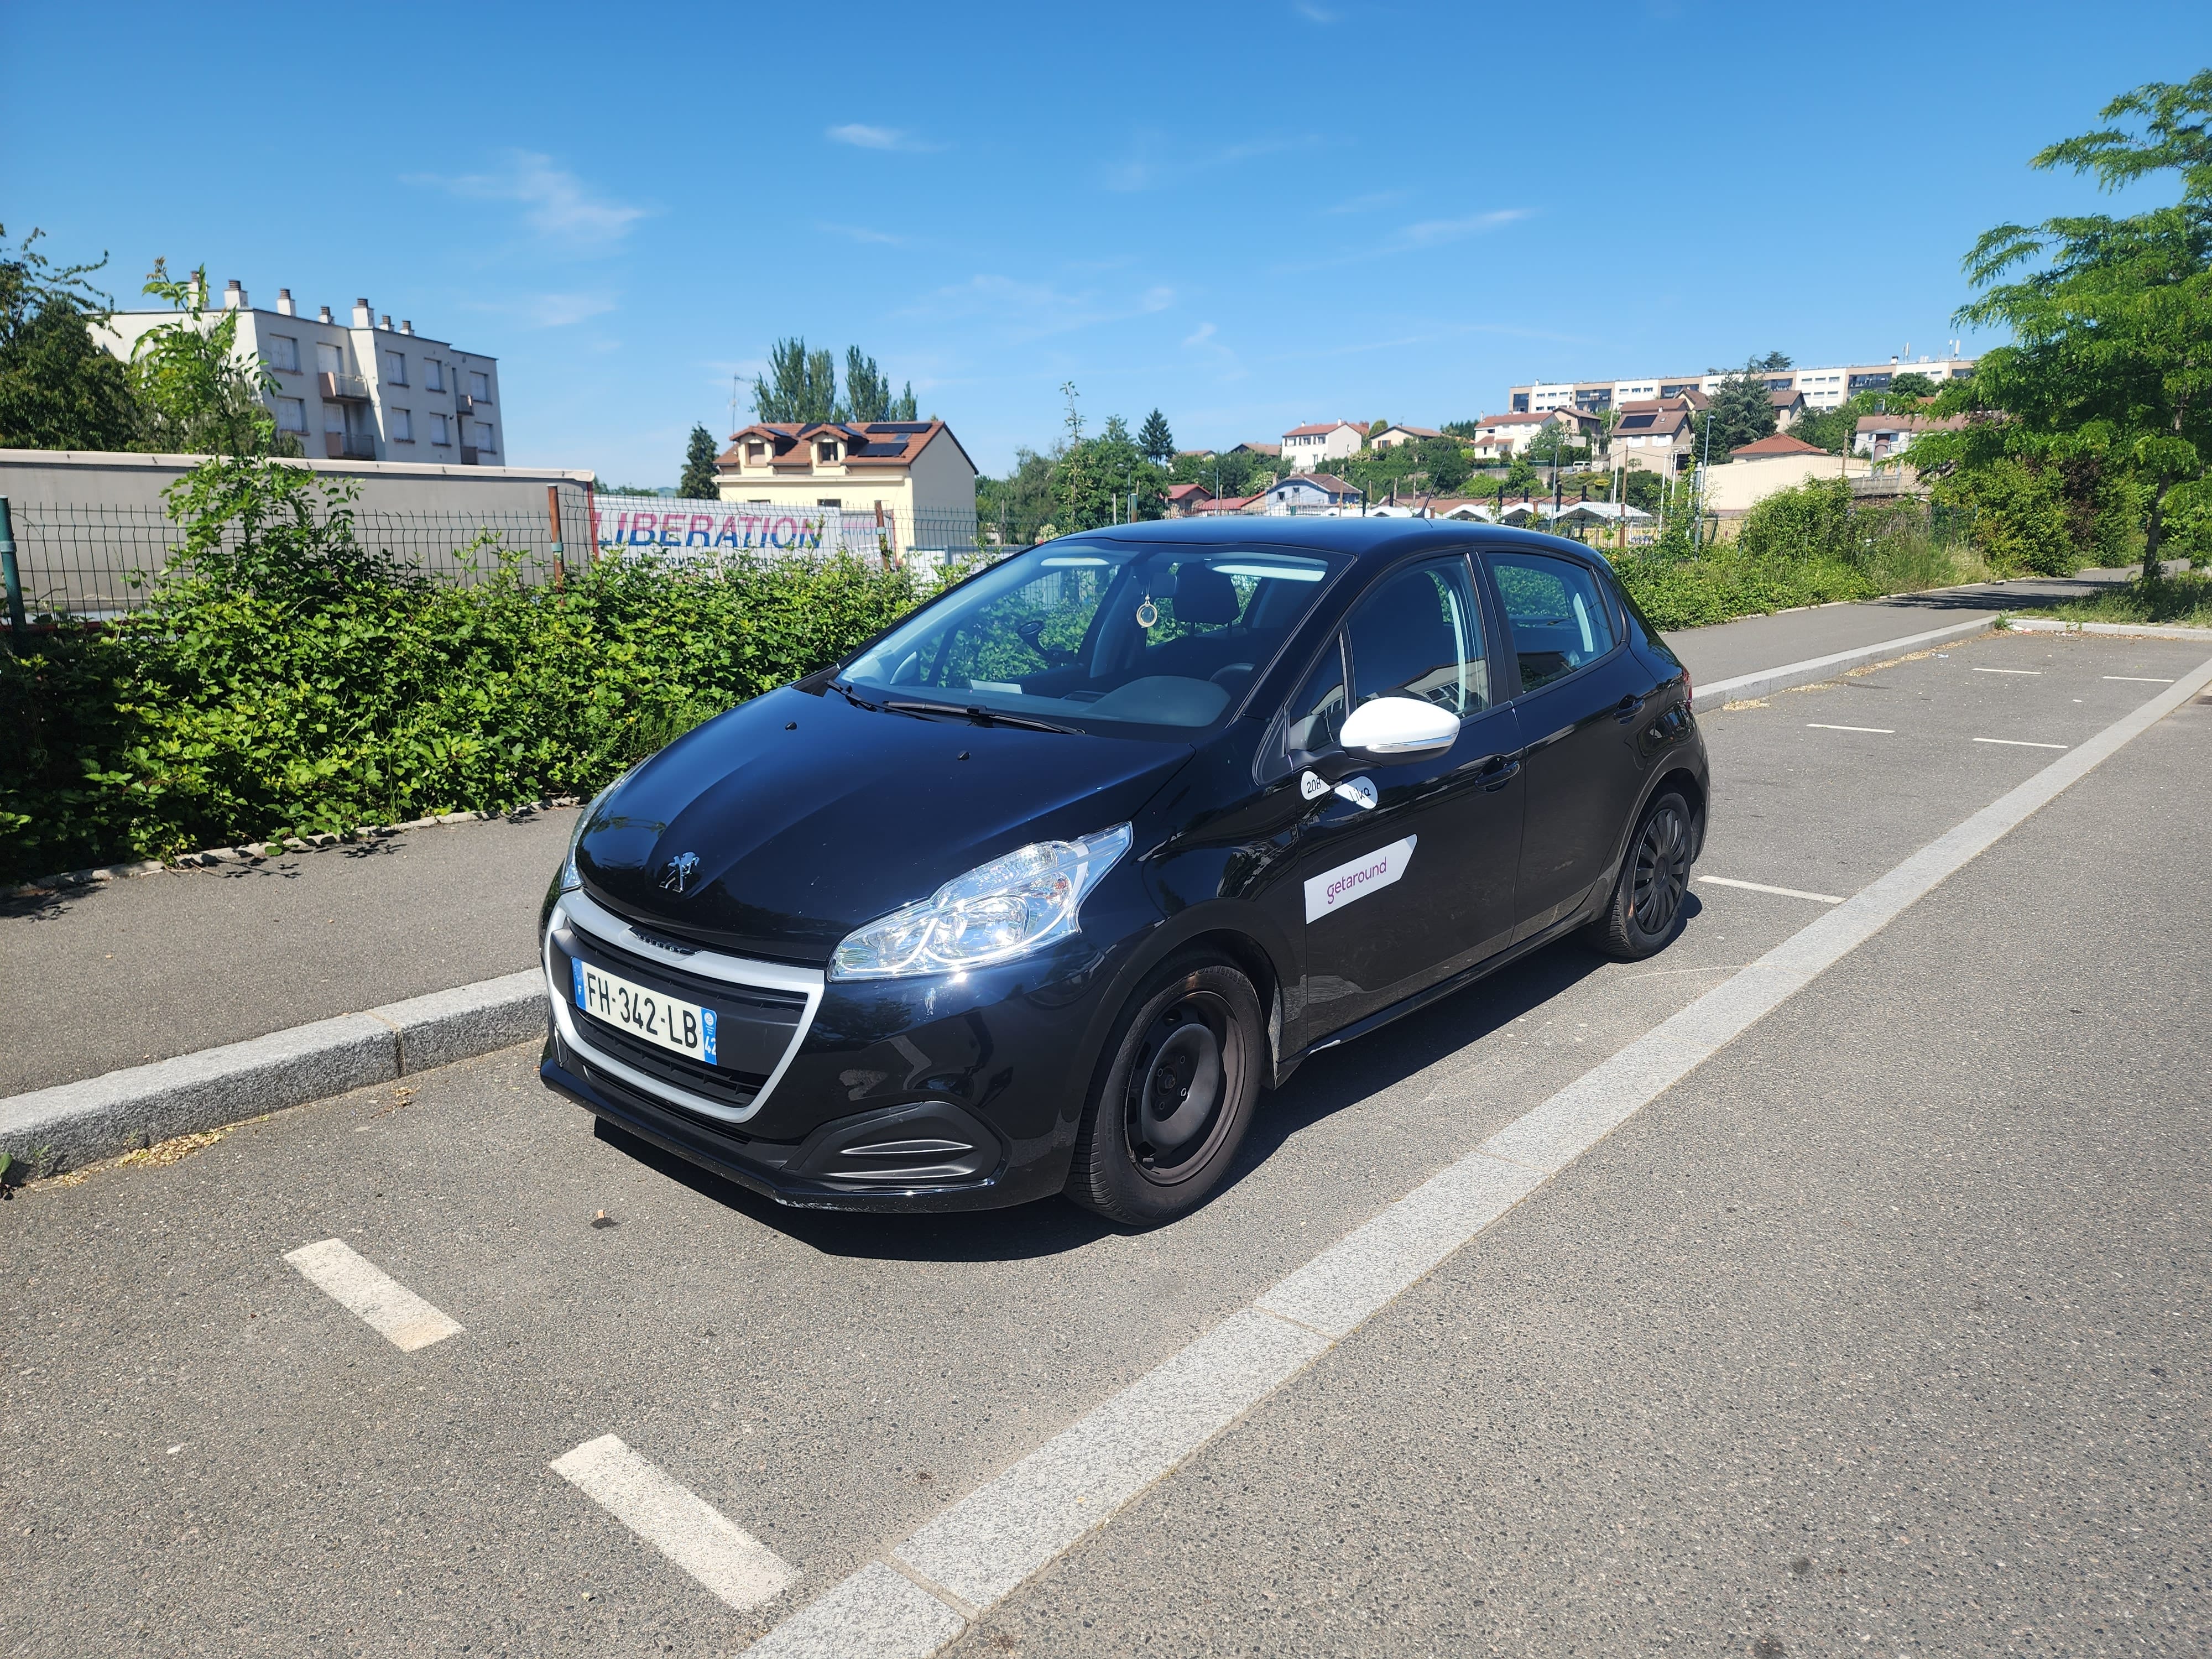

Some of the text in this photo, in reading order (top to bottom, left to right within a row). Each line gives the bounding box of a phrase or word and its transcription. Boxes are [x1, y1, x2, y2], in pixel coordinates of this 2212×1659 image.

[595, 512, 823, 549] LIBERATION
[1306, 778, 1321, 794] 208
[1327, 857, 1387, 905] getaround
[577, 985, 582, 995] F
[586, 972, 698, 1049] FH-342-LB
[705, 1036, 717, 1055] 42
